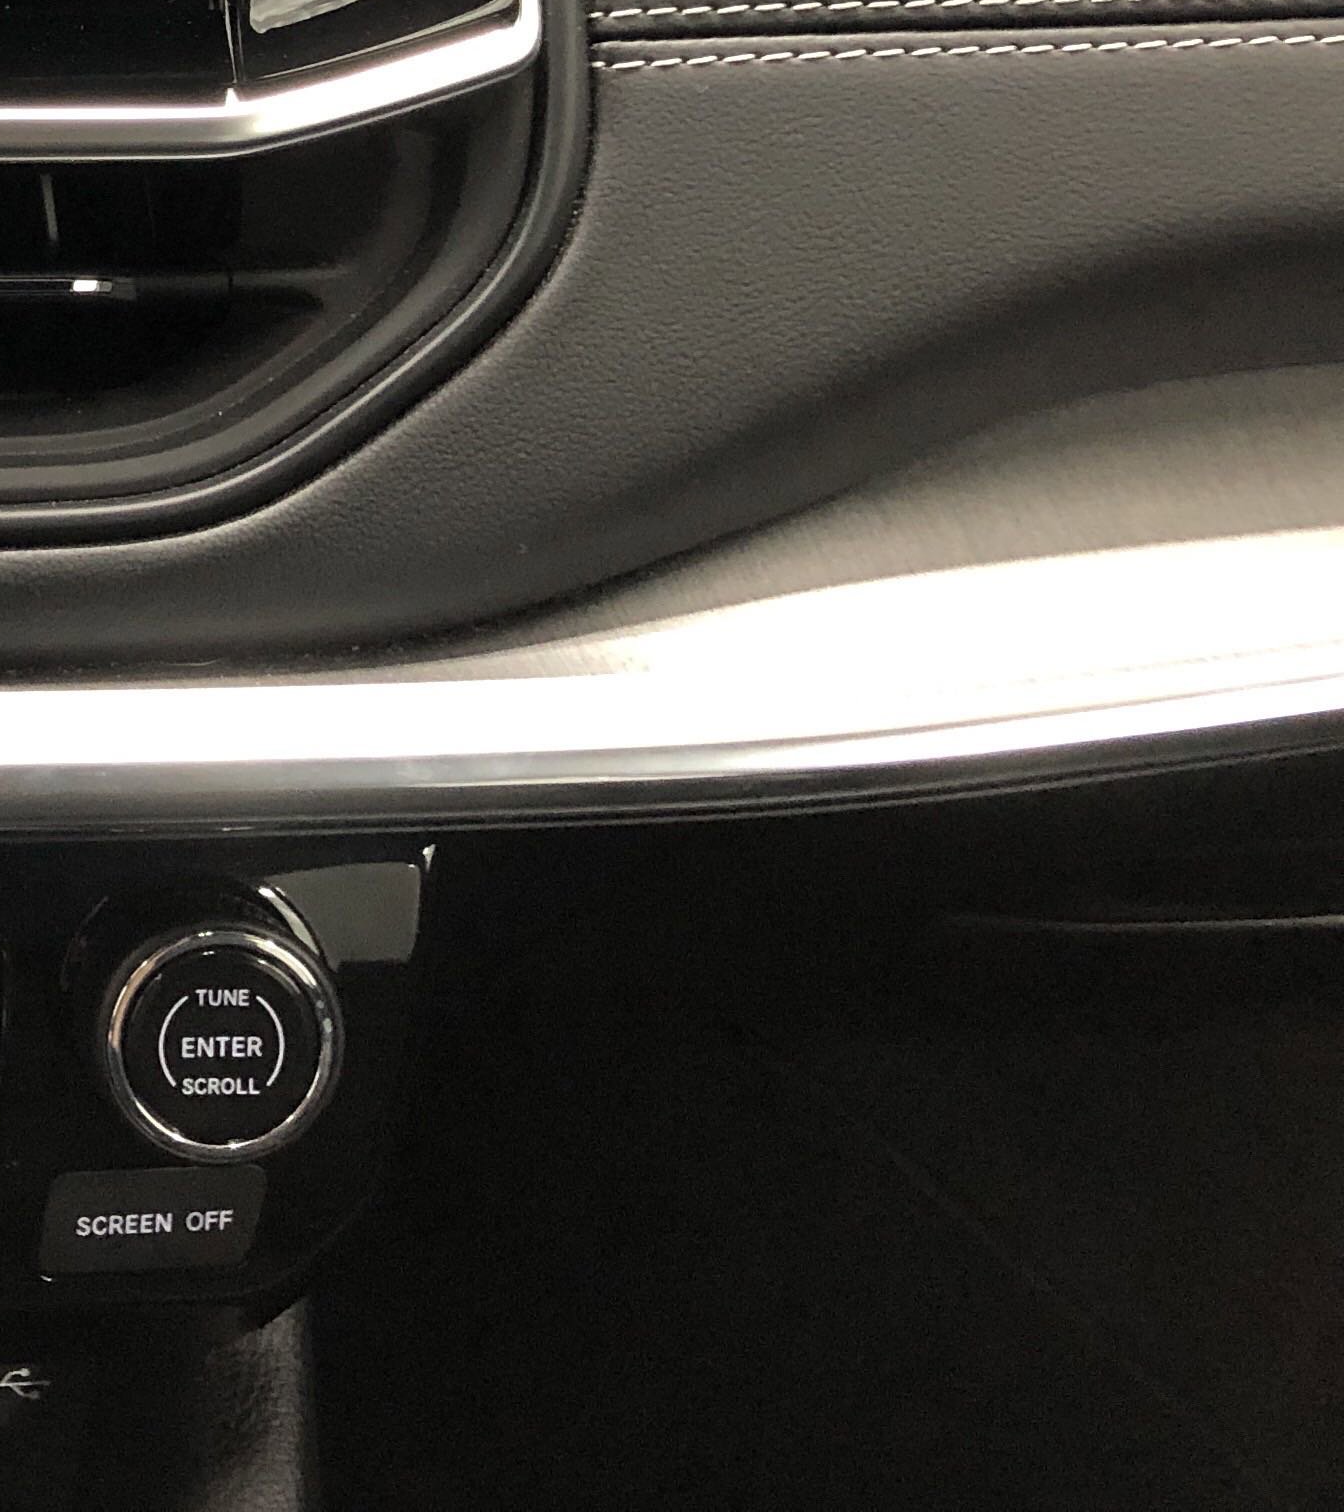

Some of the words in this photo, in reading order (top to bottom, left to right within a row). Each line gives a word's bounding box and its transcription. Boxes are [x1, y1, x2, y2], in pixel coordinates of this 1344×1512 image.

[195, 989, 250, 1007] TUNE
[181, 1037, 262, 1058] ENTER
[181, 1077, 260, 1095] SCROLL
[76, 1213, 172, 1236] SCREEN
[186, 1210, 234, 1233] OFF
